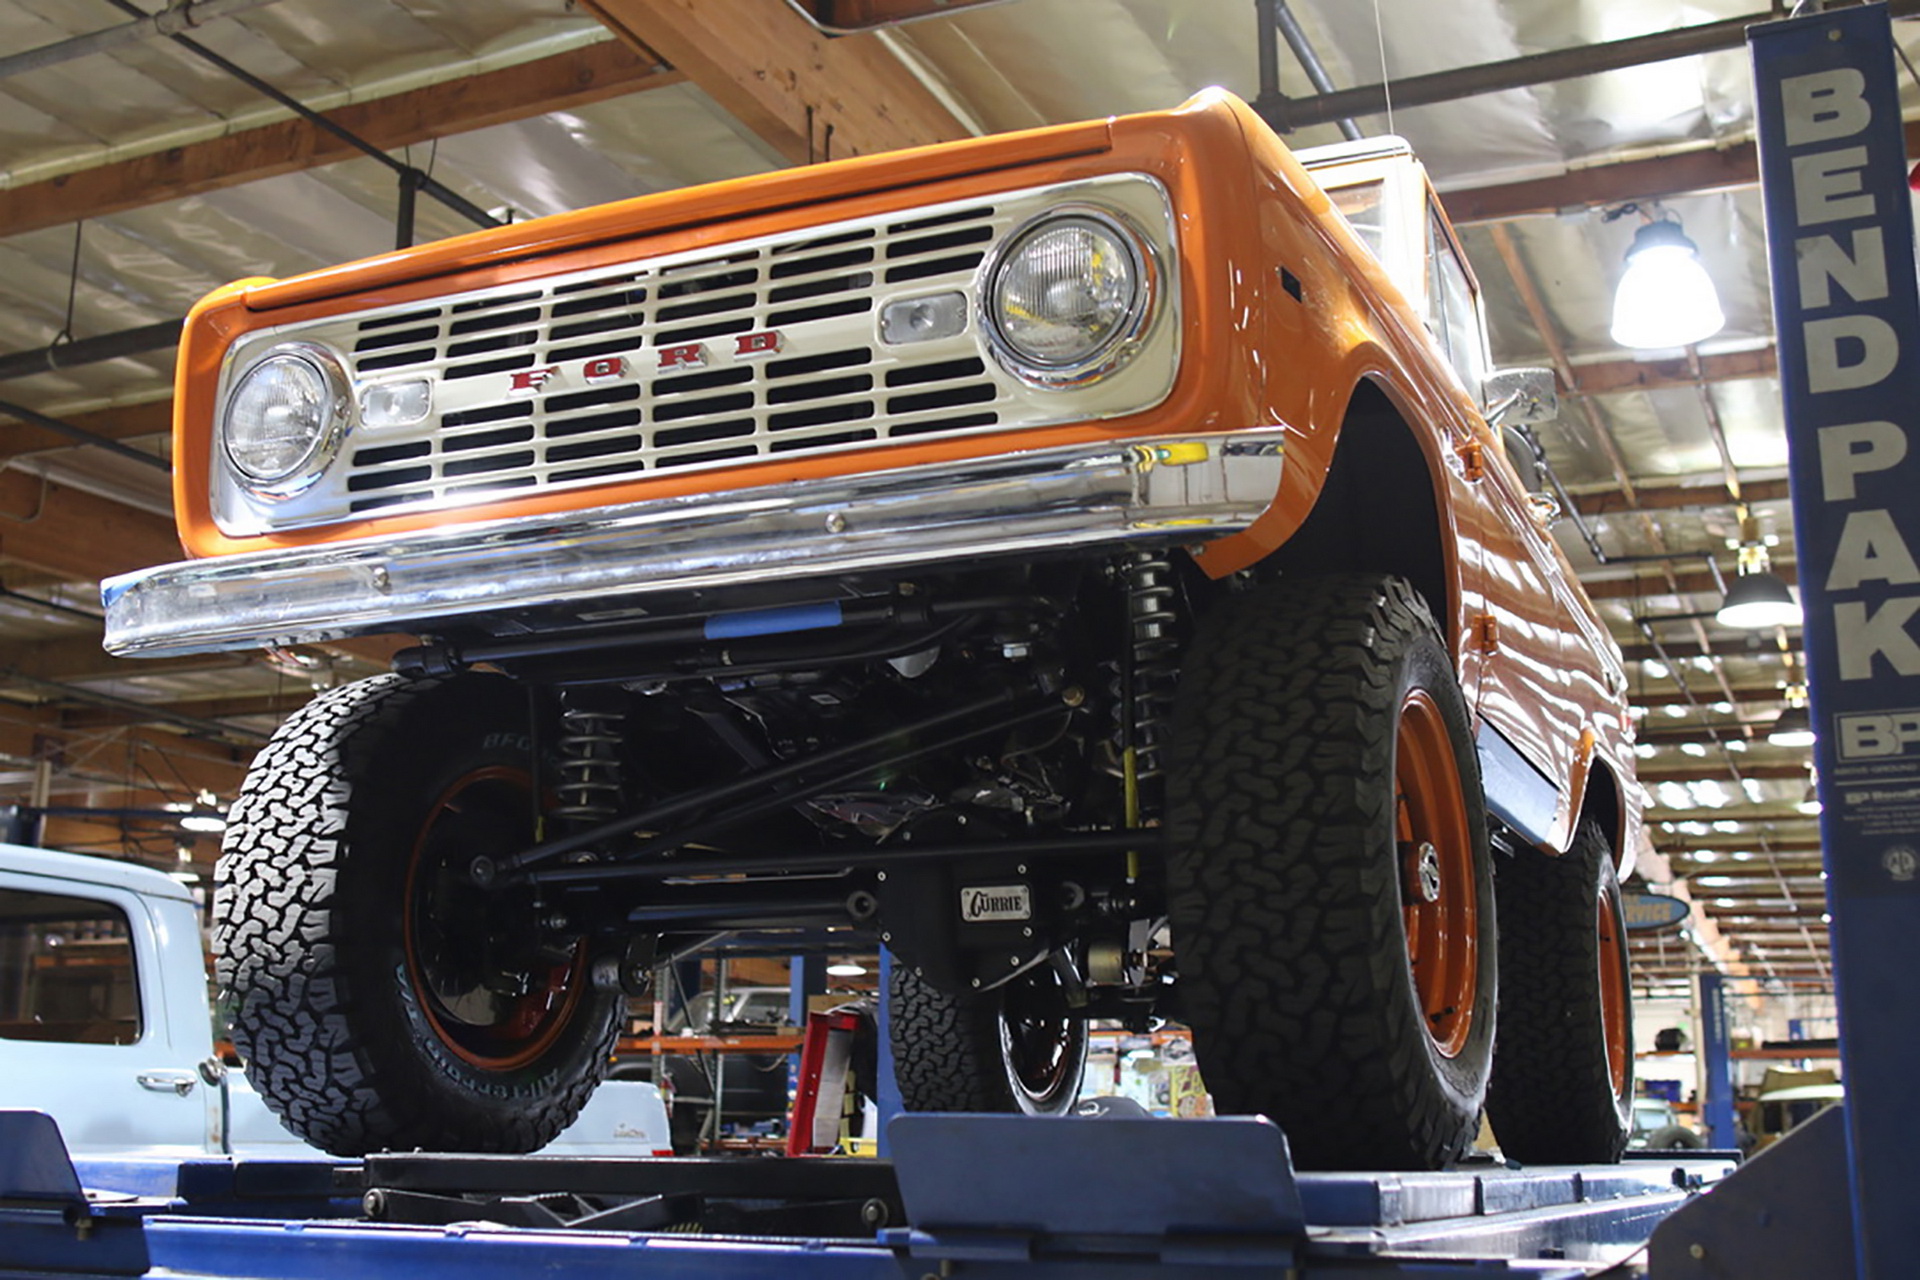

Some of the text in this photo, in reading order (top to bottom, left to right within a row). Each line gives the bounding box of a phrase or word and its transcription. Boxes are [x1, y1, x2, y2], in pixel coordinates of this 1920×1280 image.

[508, 330, 785, 397] FORD
[1841, 713, 1920, 757] BP
[971, 891, 1023, 917] CURRIE
